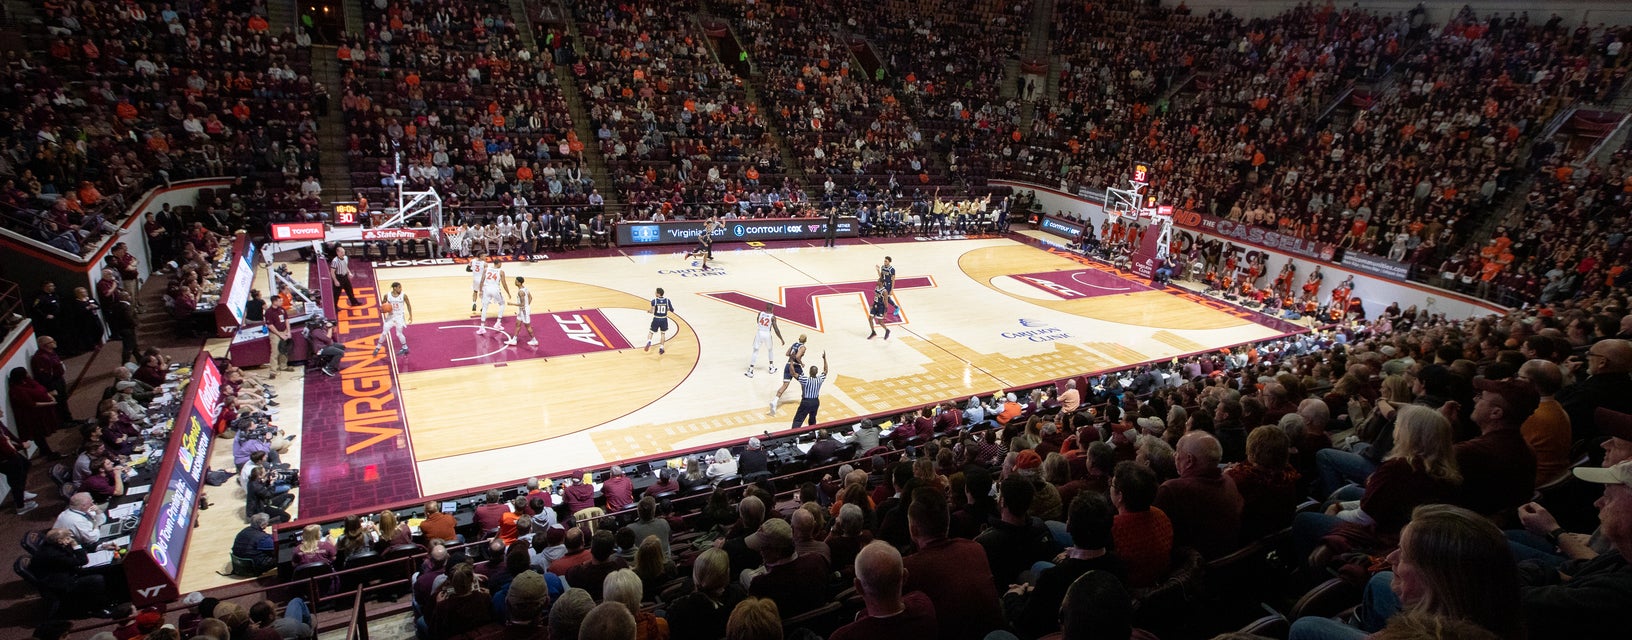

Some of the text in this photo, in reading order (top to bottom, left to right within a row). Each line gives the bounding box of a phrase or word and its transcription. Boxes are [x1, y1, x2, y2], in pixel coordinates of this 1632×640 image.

[1135, 171, 1145, 181] 30
[339, 213, 353, 223] 30
[787, 225, 802, 233] COX
[1202, 218, 1217, 229] THE
[1216, 220, 1320, 259] CASSELL
[474, 264, 480, 273] 3
[486, 272, 498, 281] 24
[1024, 276, 1087, 297] ACC
[656, 305, 667, 314] 10
[1162, 286, 1253, 319] TECH
[759, 316, 770, 327] 42
[552, 314, 605, 347] ACC
[1001, 326, 1063, 340] CARILION
[1028, 332, 1072, 344] CLINIC
[339, 333, 404, 455] VIRGINIA
[190, 432, 210, 482] WASHINGTON
[160, 516, 174, 543] Town
[167, 488, 184, 524] Printing
[136, 583, 168, 598] VT
